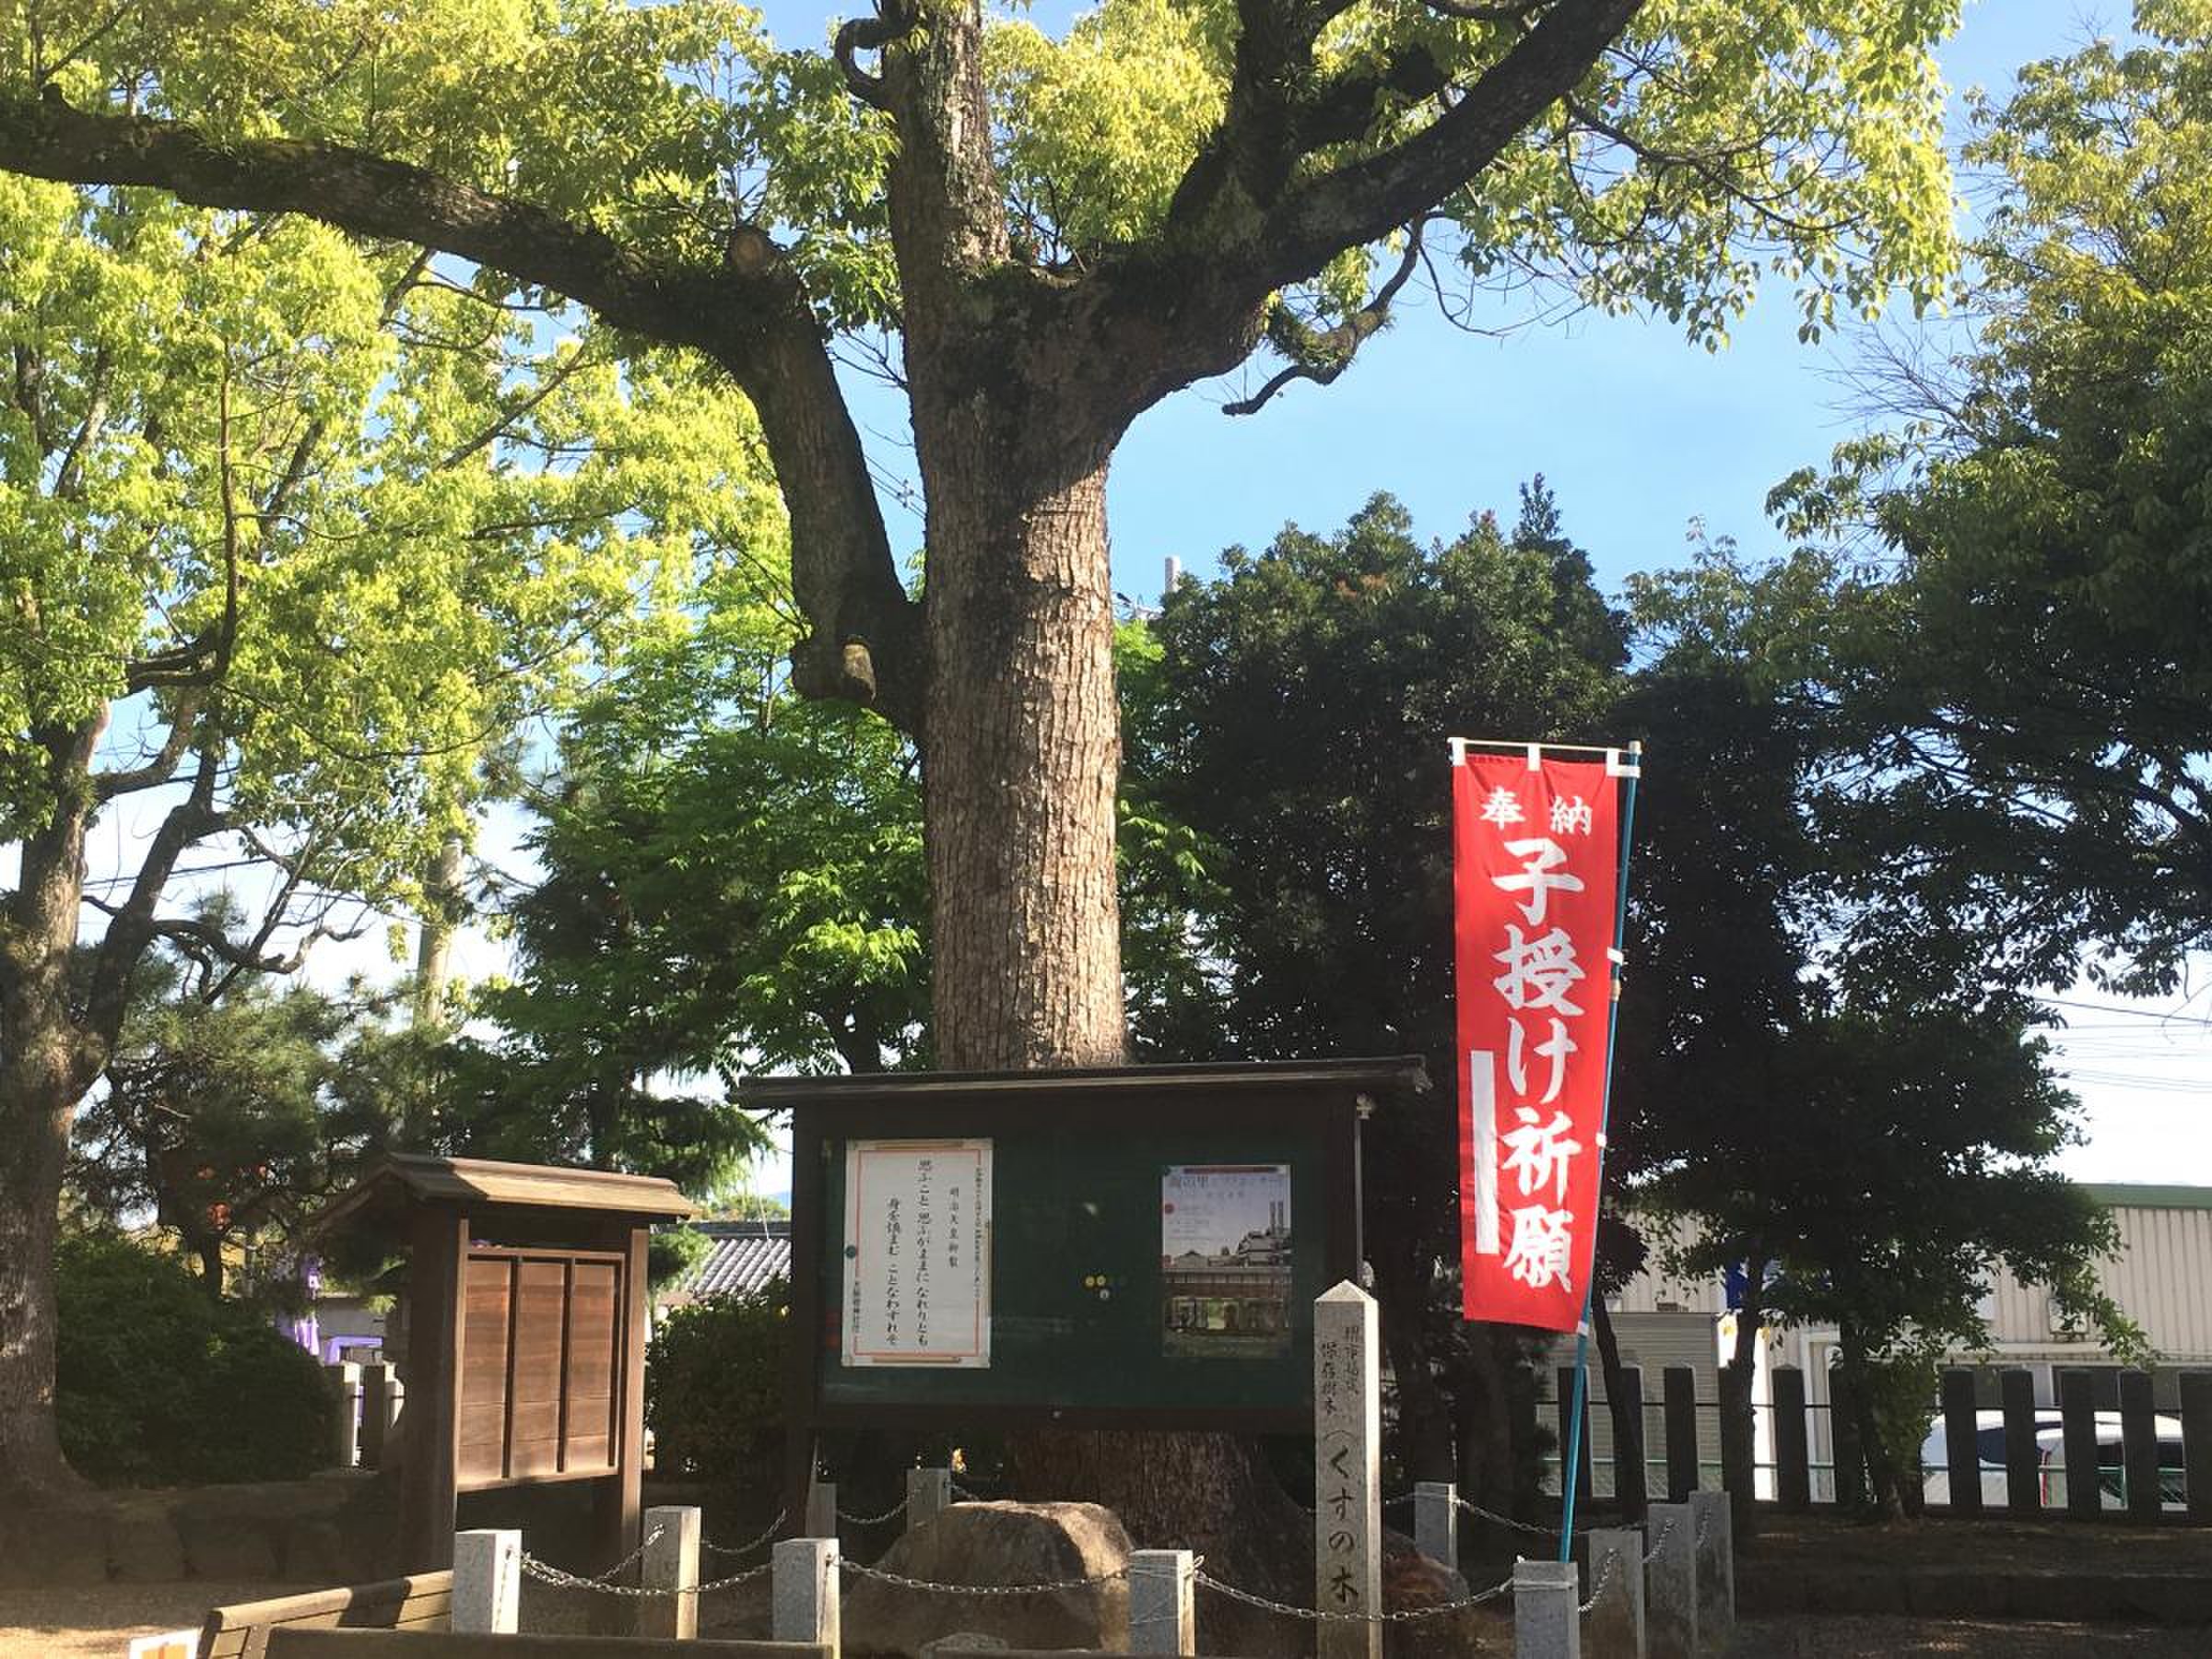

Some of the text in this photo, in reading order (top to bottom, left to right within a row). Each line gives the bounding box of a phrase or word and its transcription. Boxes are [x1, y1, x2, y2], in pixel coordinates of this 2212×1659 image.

[1480, 785, 1593, 836] 奉納
[1490, 837, 1584, 1293] 子授け祈願
